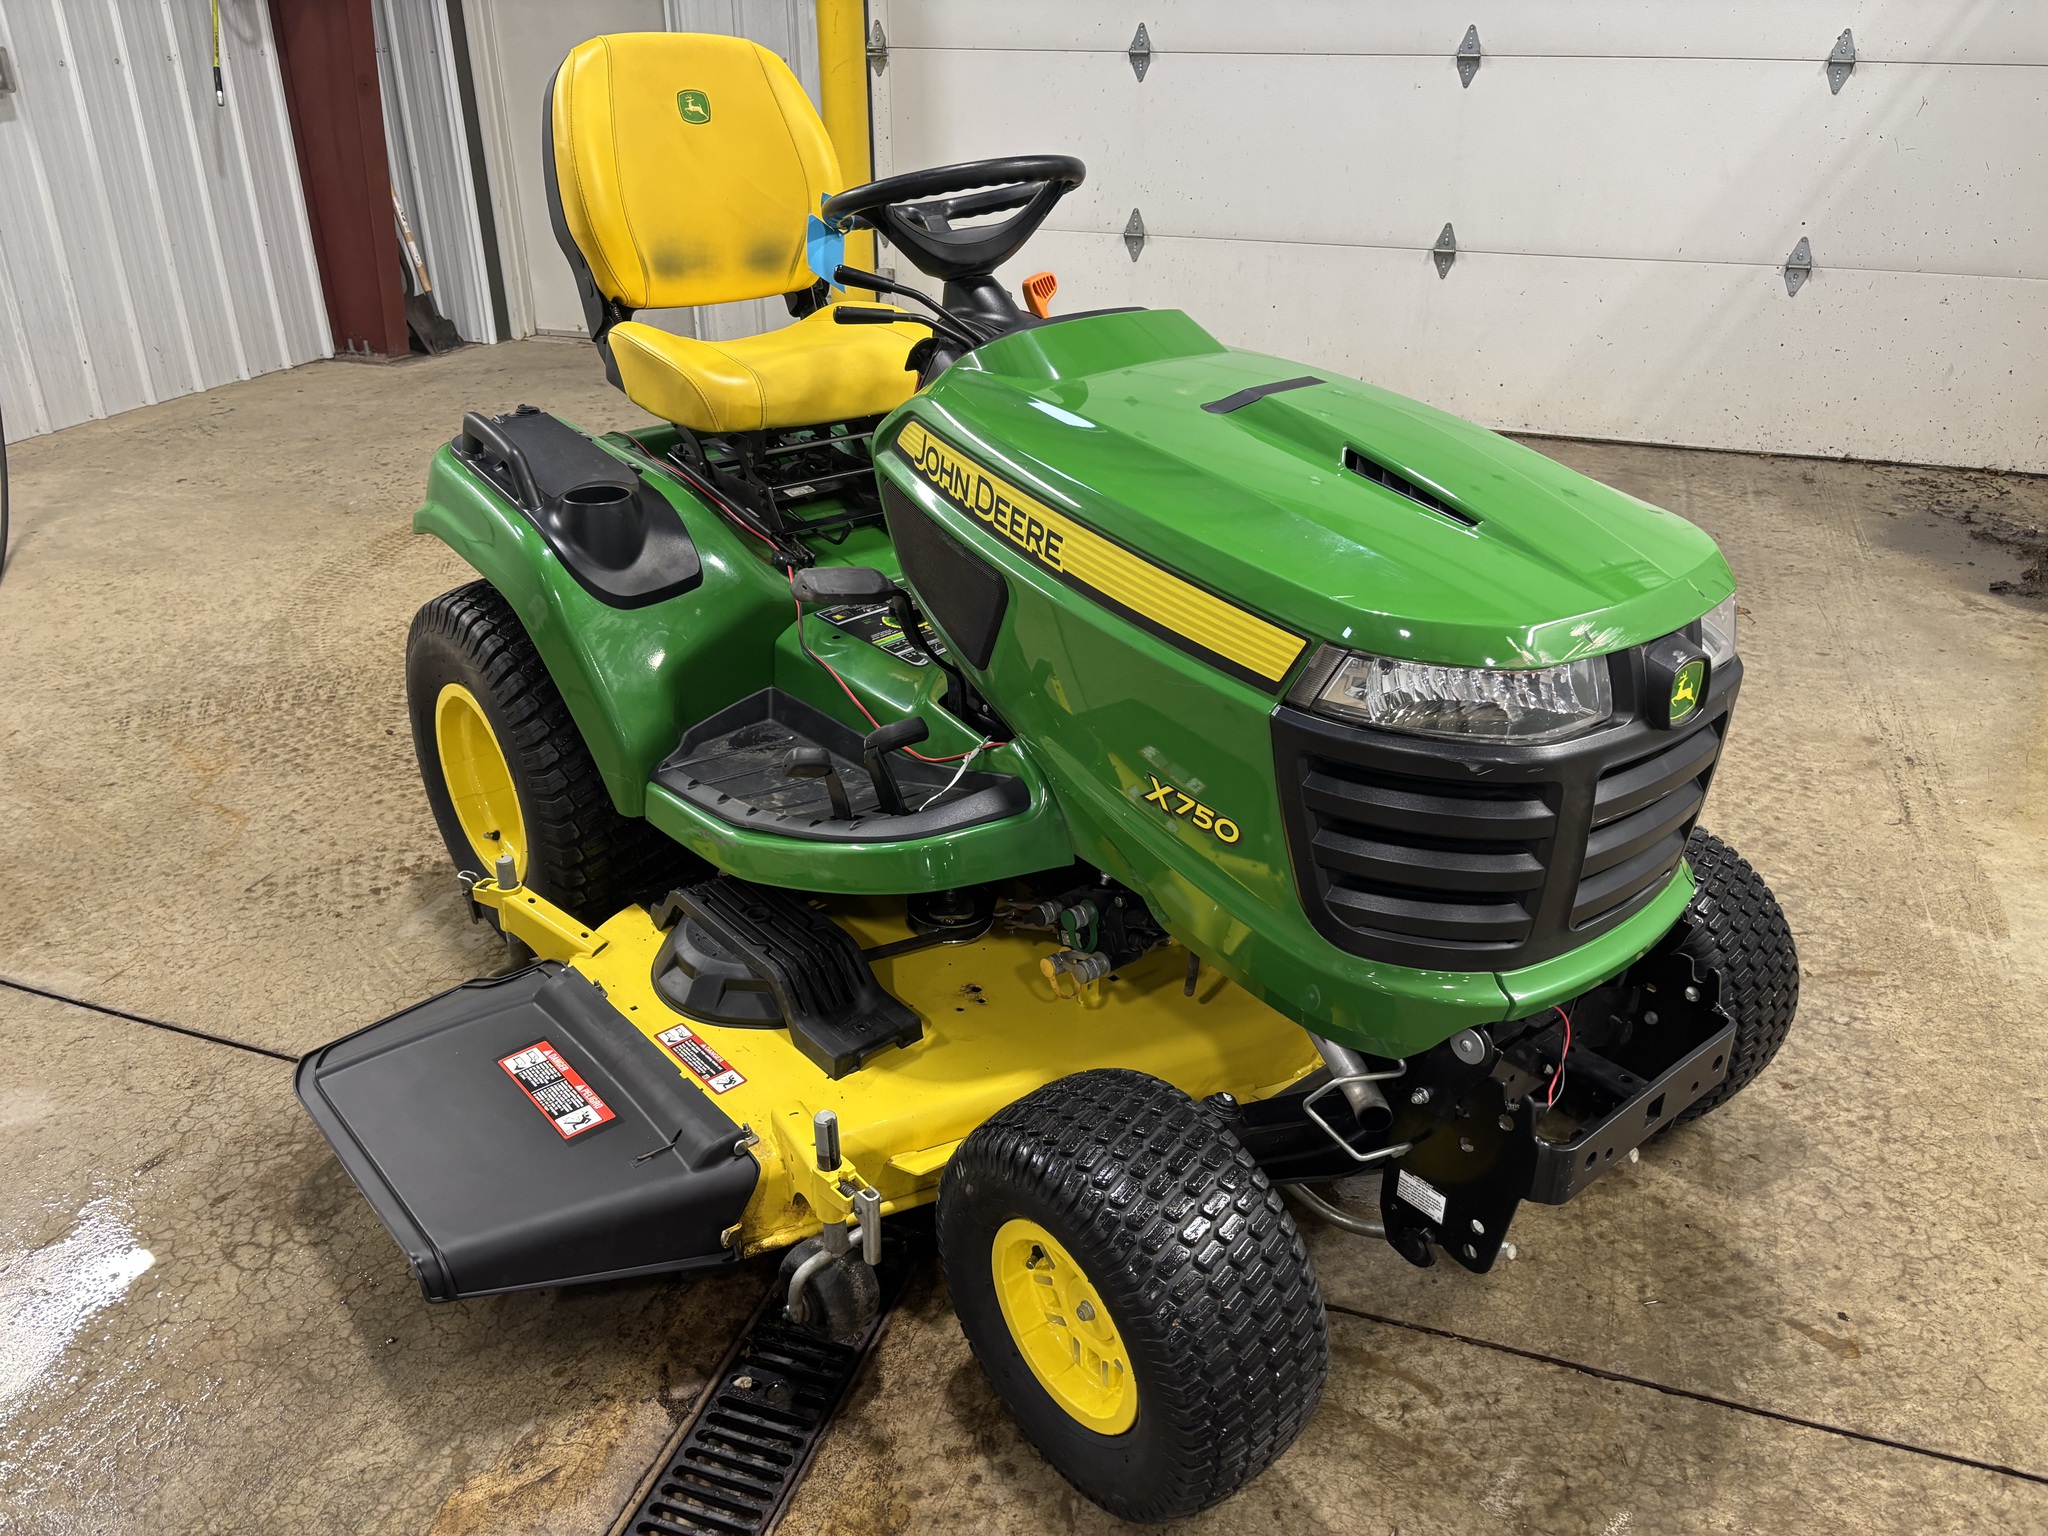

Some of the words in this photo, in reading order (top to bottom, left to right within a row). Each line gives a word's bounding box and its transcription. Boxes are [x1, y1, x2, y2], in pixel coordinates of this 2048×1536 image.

[914, 434, 971, 502] JOHN
[974, 474, 1064, 566] DEERE
[1143, 773, 1240, 844] X750
[548, 1053, 569, 1072] DANGER
[704, 1046, 724, 1063] DANGER
[580, 1088, 604, 1109] PELIGRO
